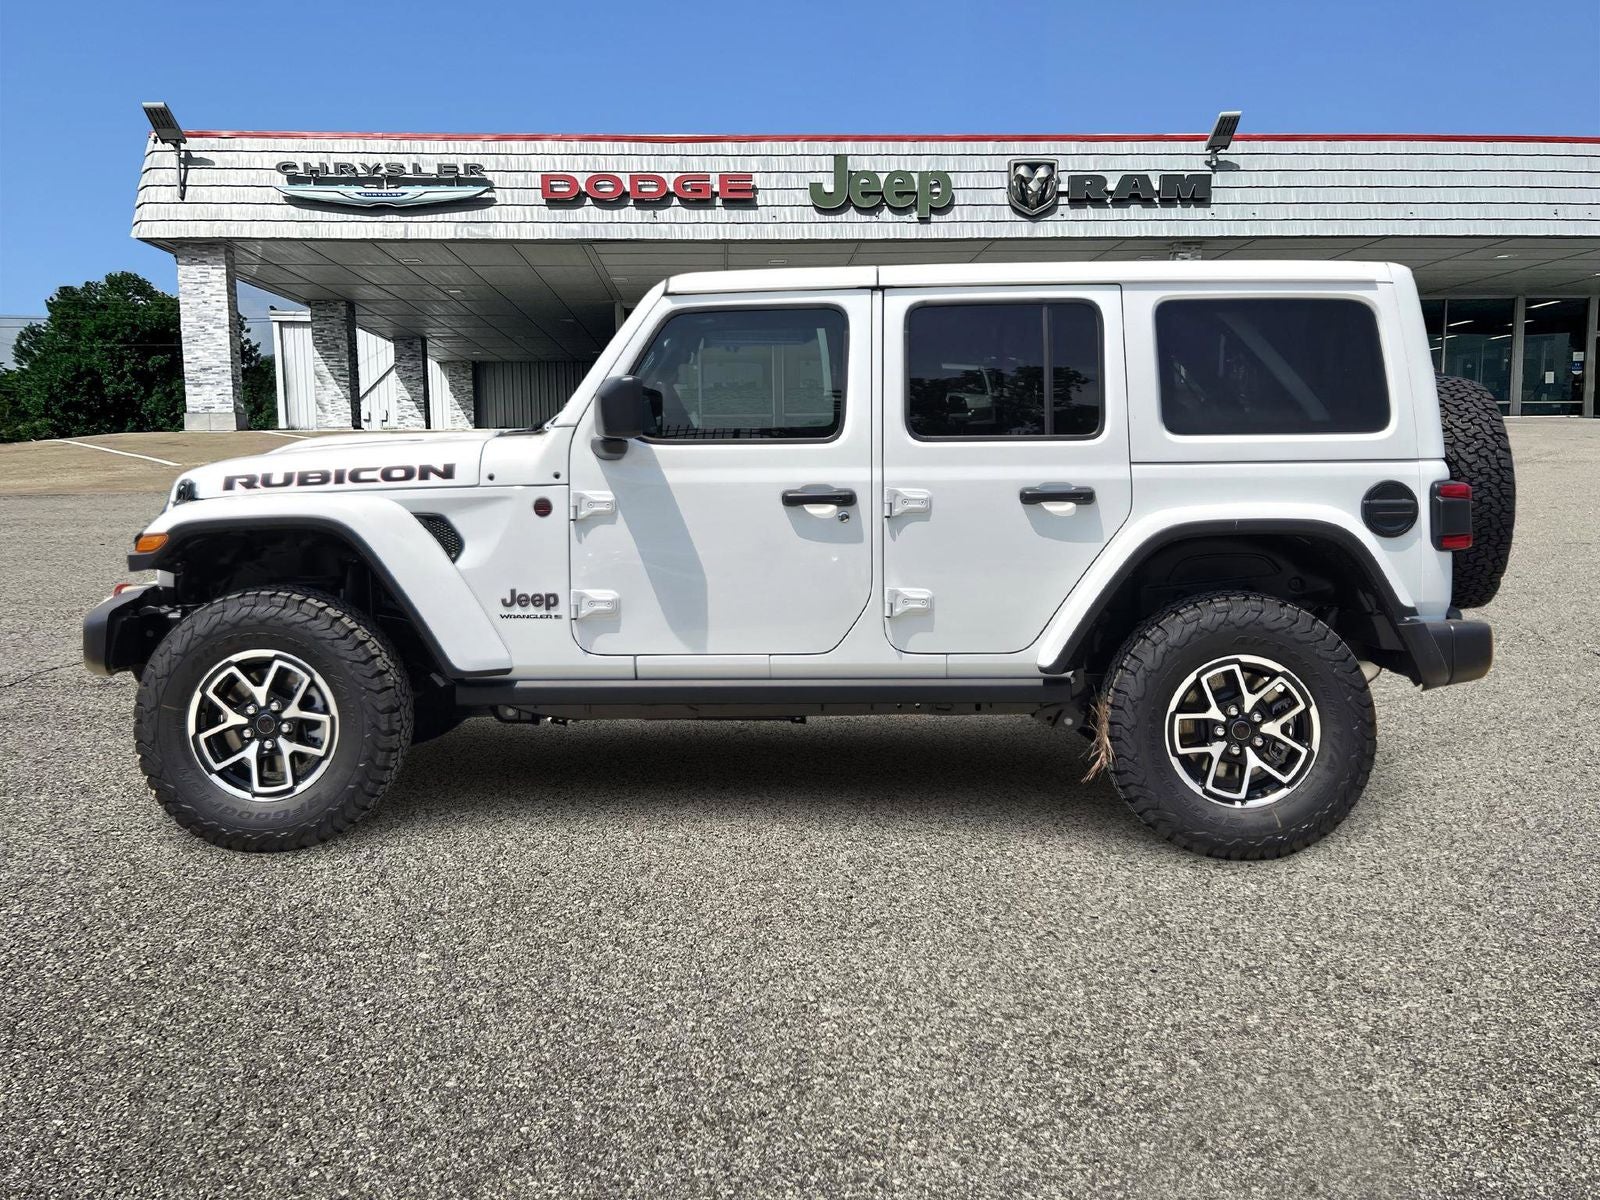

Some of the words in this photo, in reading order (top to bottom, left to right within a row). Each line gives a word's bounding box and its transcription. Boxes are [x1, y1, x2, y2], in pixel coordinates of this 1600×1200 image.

[275, 161, 486, 178] CHRYSLER
[540, 173, 755, 201] DODGE
[808, 155, 954, 219] Jeep
[1068, 173, 1213, 200] RAM
[222, 463, 456, 491] RUBICON
[501, 588, 559, 611] Jeep
